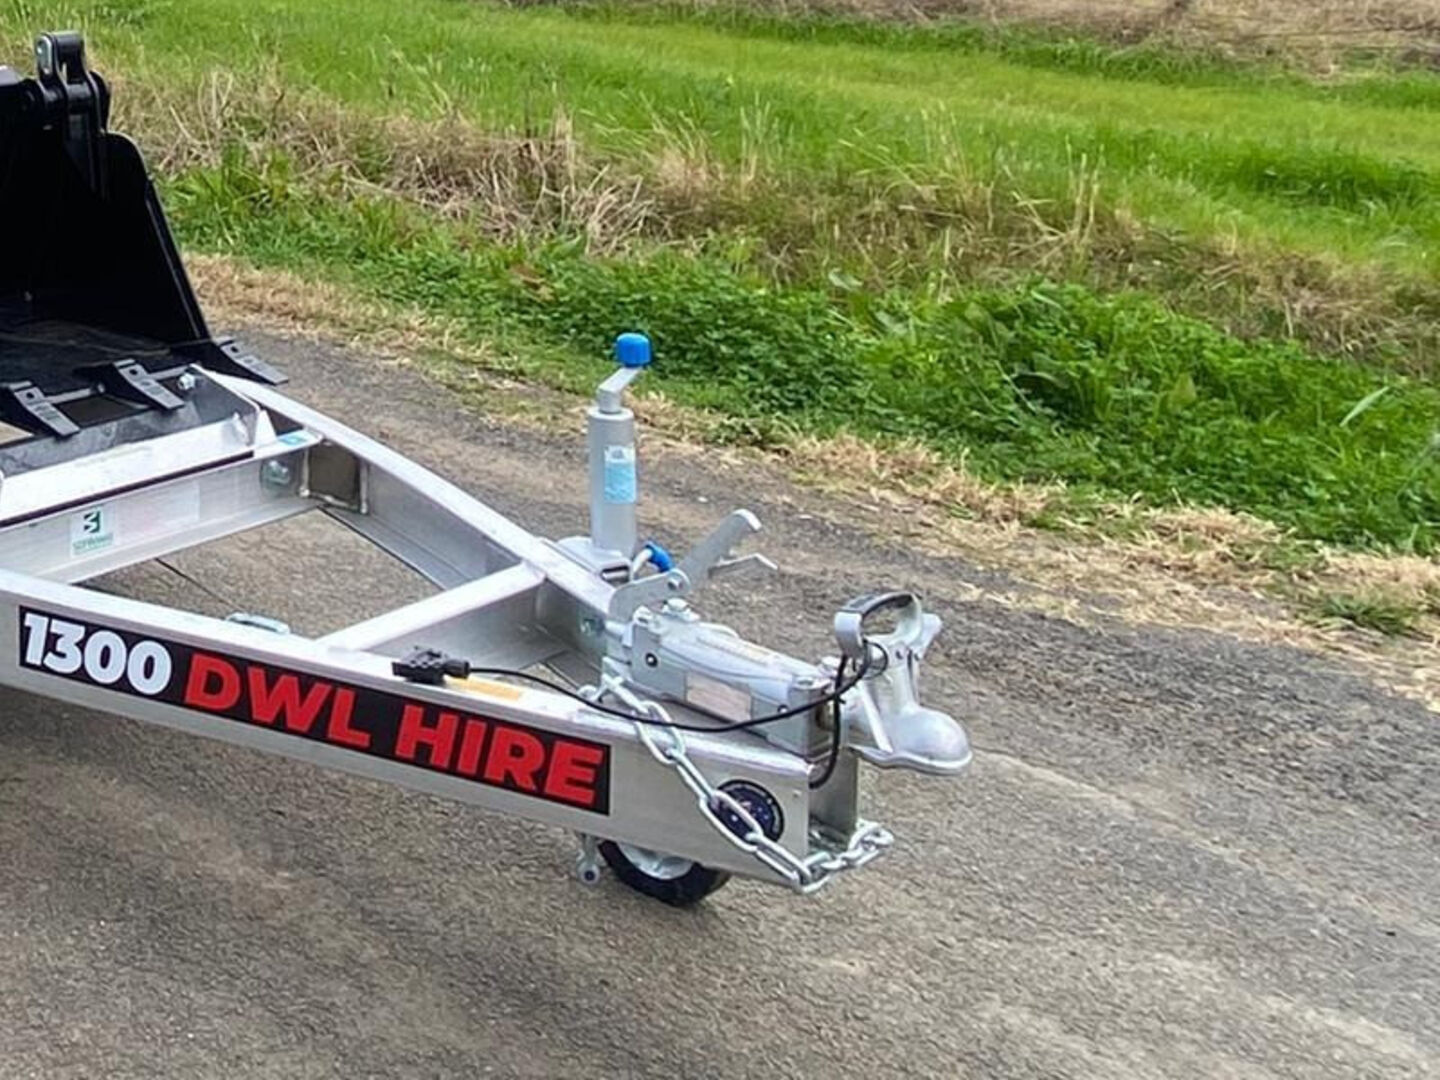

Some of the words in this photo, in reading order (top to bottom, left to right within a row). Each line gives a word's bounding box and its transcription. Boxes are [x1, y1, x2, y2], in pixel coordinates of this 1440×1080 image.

[23, 612, 173, 696] 1300
[184, 652, 373, 749] DWL
[395, 705, 605, 808] HIRE
